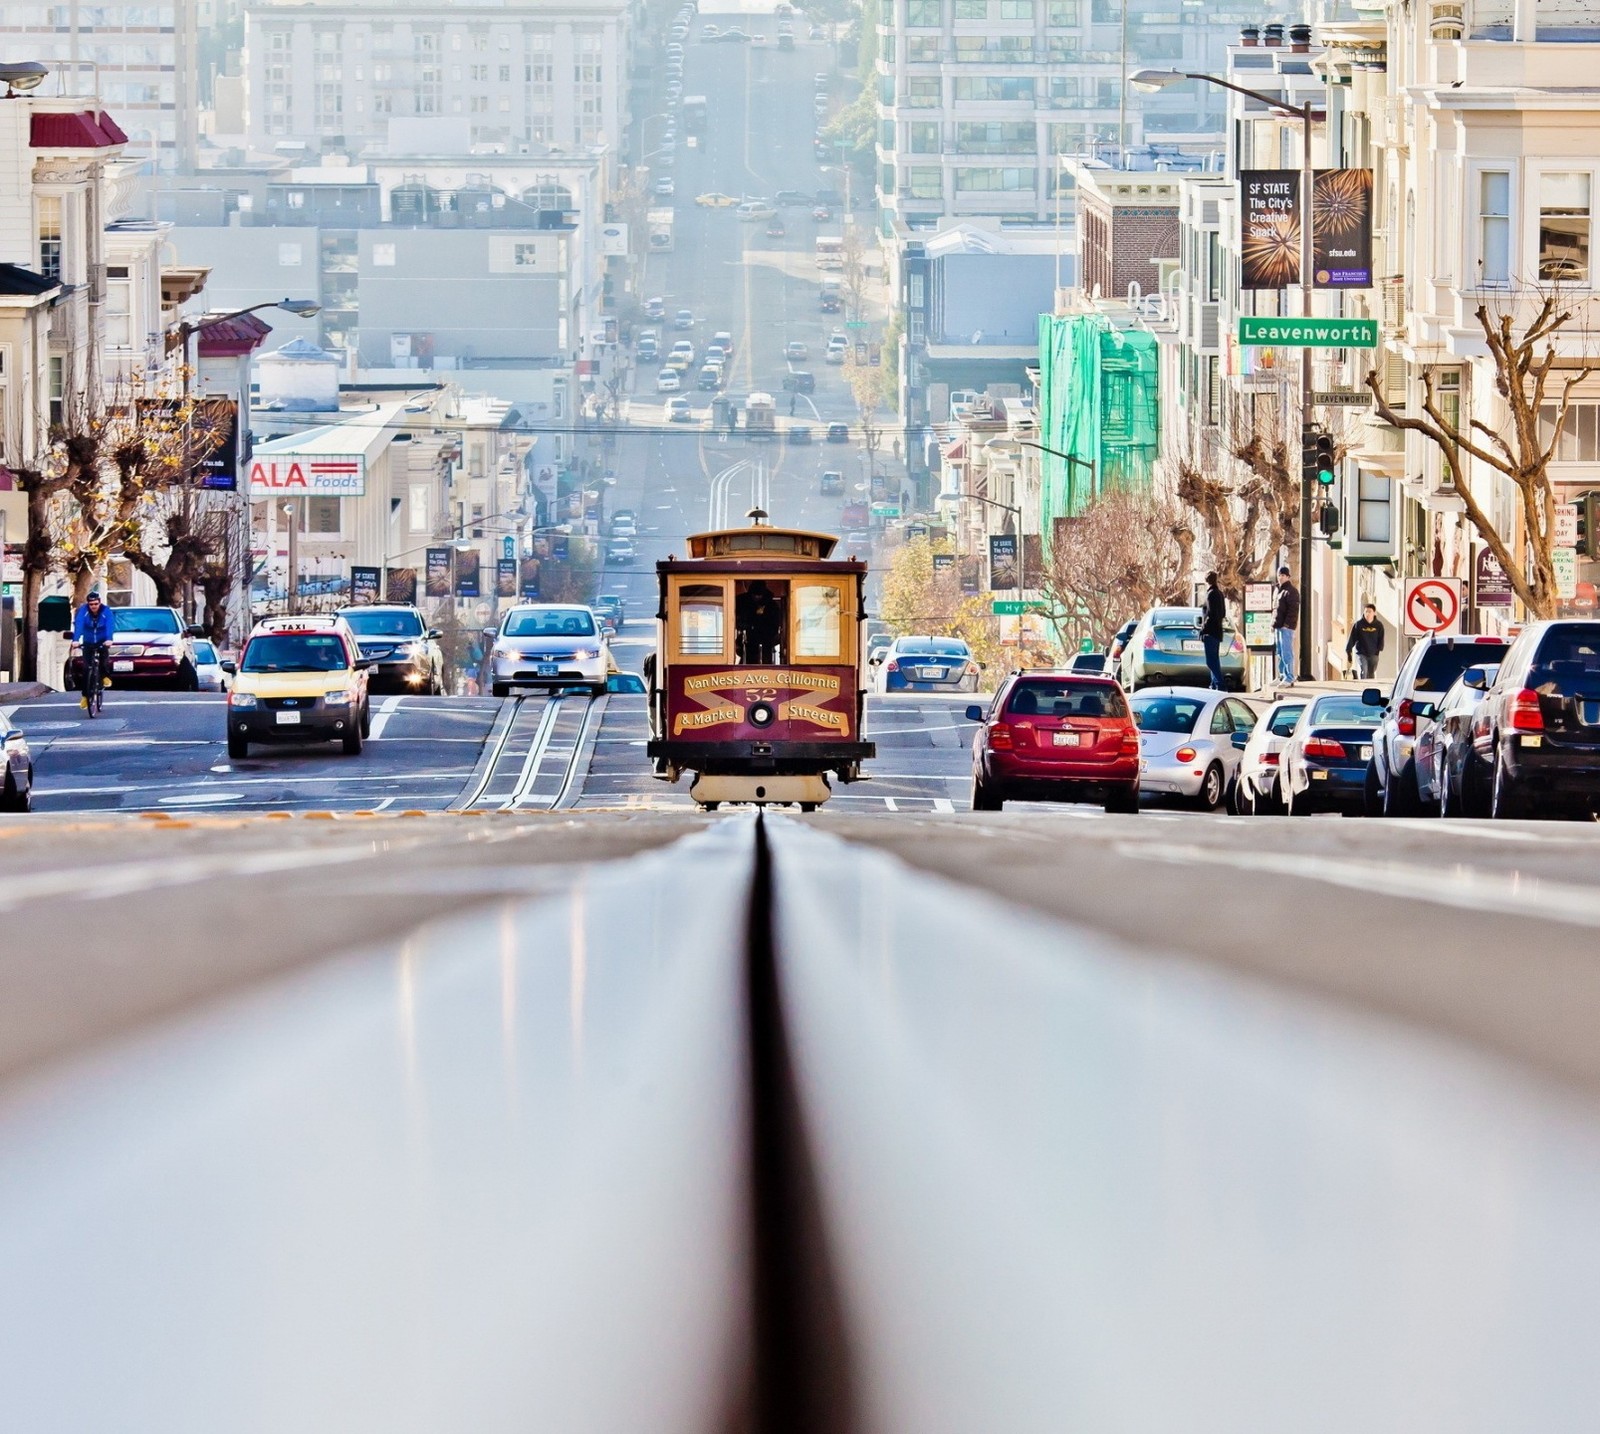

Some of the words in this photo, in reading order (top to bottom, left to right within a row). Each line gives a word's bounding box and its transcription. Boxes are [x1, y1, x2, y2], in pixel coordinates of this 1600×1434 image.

[1249, 183, 1261, 194] SF
[1263, 183, 1290, 194] STATE
[1249, 198, 1266, 208] The
[1268, 198, 1293, 210] City's
[1249, 212, 1288, 223] Creative
[1249, 227, 1277, 239] Spark
[1328, 248, 1357, 257] sfsu.edu
[1245, 324, 1372, 341] Leavenworth
[1316, 395, 1370, 404] LEAVENWORTH
[250, 462, 308, 488] ALA
[314, 474, 358, 488] Foods
[1560, 519, 1565, 527] 8
[1559, 565, 1564, 573] 9
[1246, 614, 1253, 623] 2
[688, 679, 709, 689] Van
[710, 675, 741, 686] Ness
[776, 673, 838, 689] California
[745, 688, 777, 702] 52
[681, 713, 691, 725] &
[694, 708, 738, 724] Market
[789, 705, 841, 723] Streets
